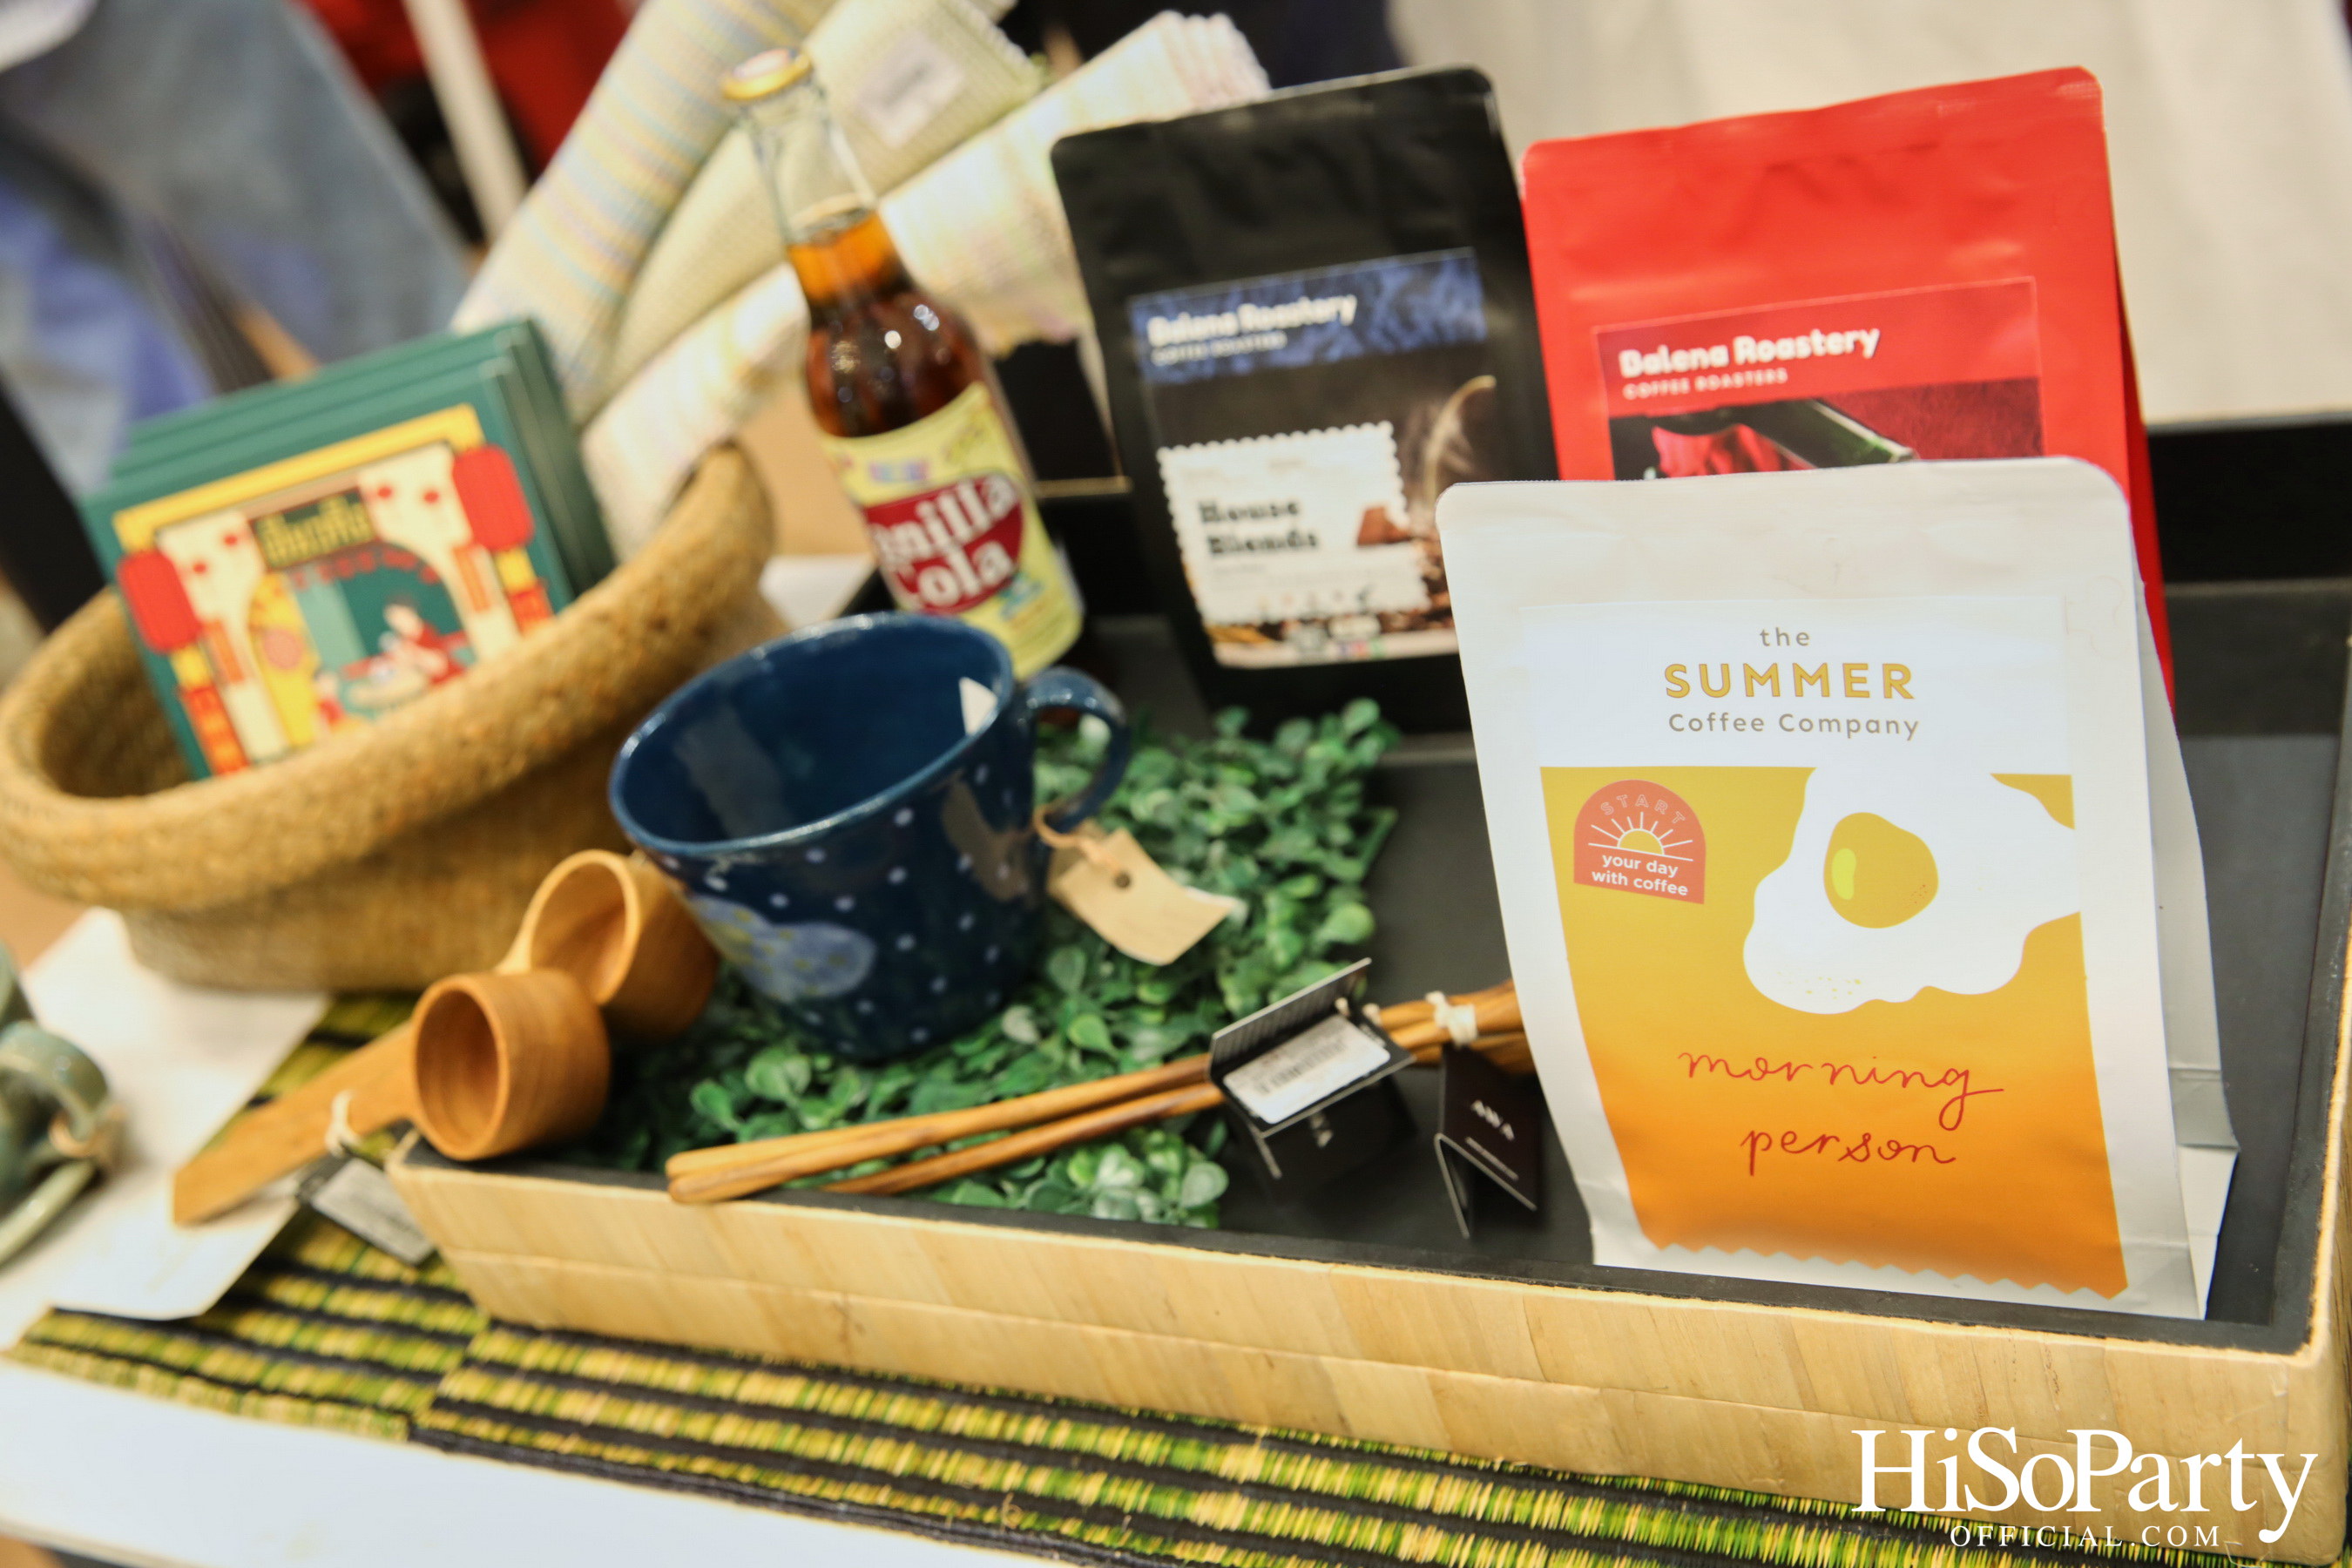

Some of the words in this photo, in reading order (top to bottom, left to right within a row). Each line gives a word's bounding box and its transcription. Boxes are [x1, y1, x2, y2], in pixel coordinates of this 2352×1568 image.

[1733, 328, 1881, 365] Roastery
[1623, 378, 1691, 400] COFFEE
[1694, 368, 1788, 391] ROASTERS
[1760, 626, 1811, 647] the
[1664, 662, 1916, 700] SUMMER
[1667, 713, 1766, 733] Coffee
[1778, 713, 1920, 741] Company
[1600, 794, 1686, 824] START
[1591, 869, 1628, 886] with
[1632, 877, 1689, 896] coffee
[1602, 855, 1642, 870] your
[1646, 860, 1679, 879] day
[1677, 1051, 2004, 1132] morning
[1740, 1130, 1957, 1177] person
